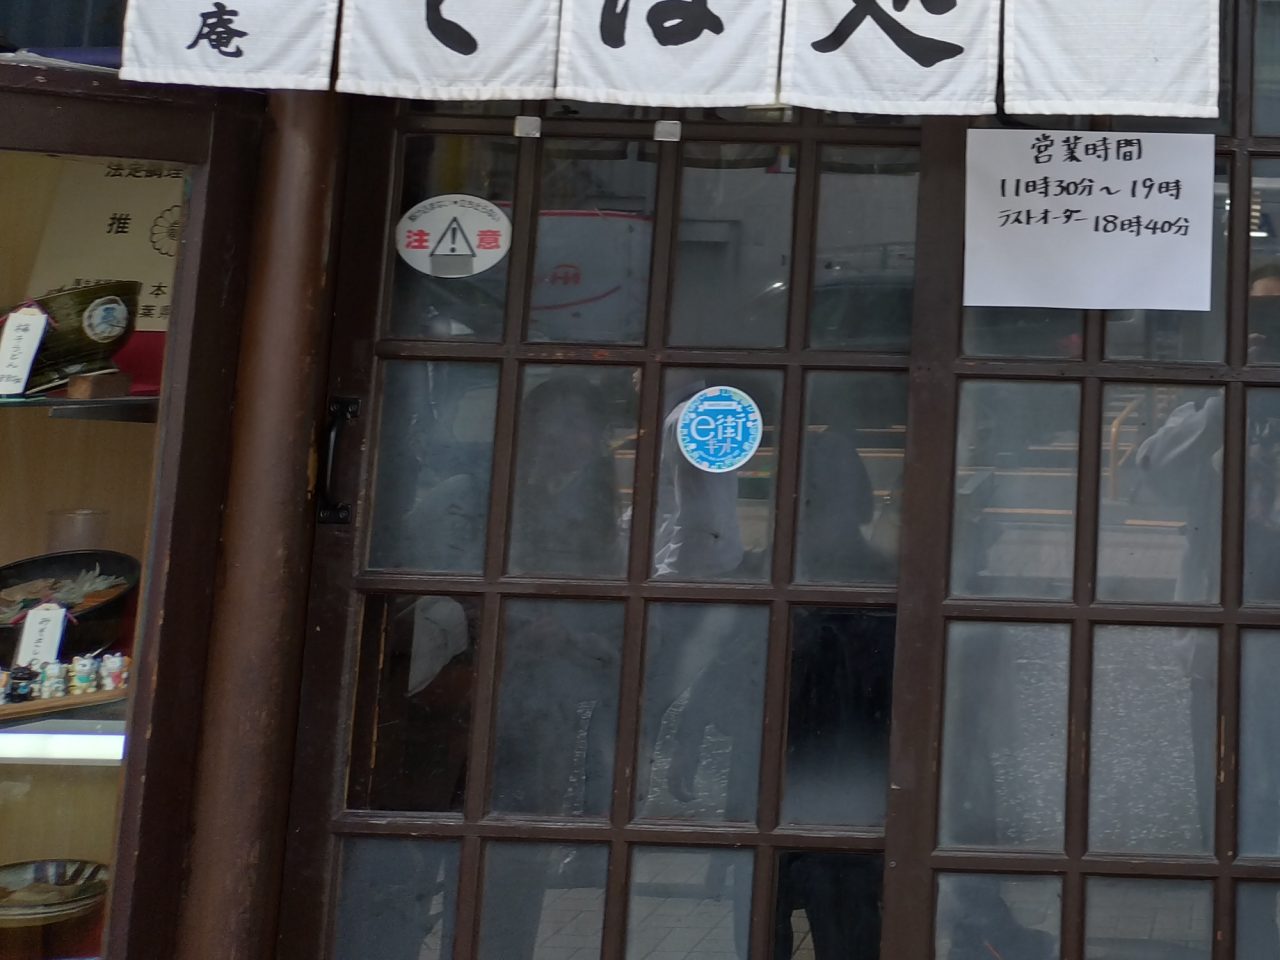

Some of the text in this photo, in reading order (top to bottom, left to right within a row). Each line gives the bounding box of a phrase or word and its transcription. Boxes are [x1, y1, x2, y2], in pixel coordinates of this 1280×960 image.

[1031, 134, 1142, 164] 営業時間
[1093, 214, 1190, 237] 18時40分
